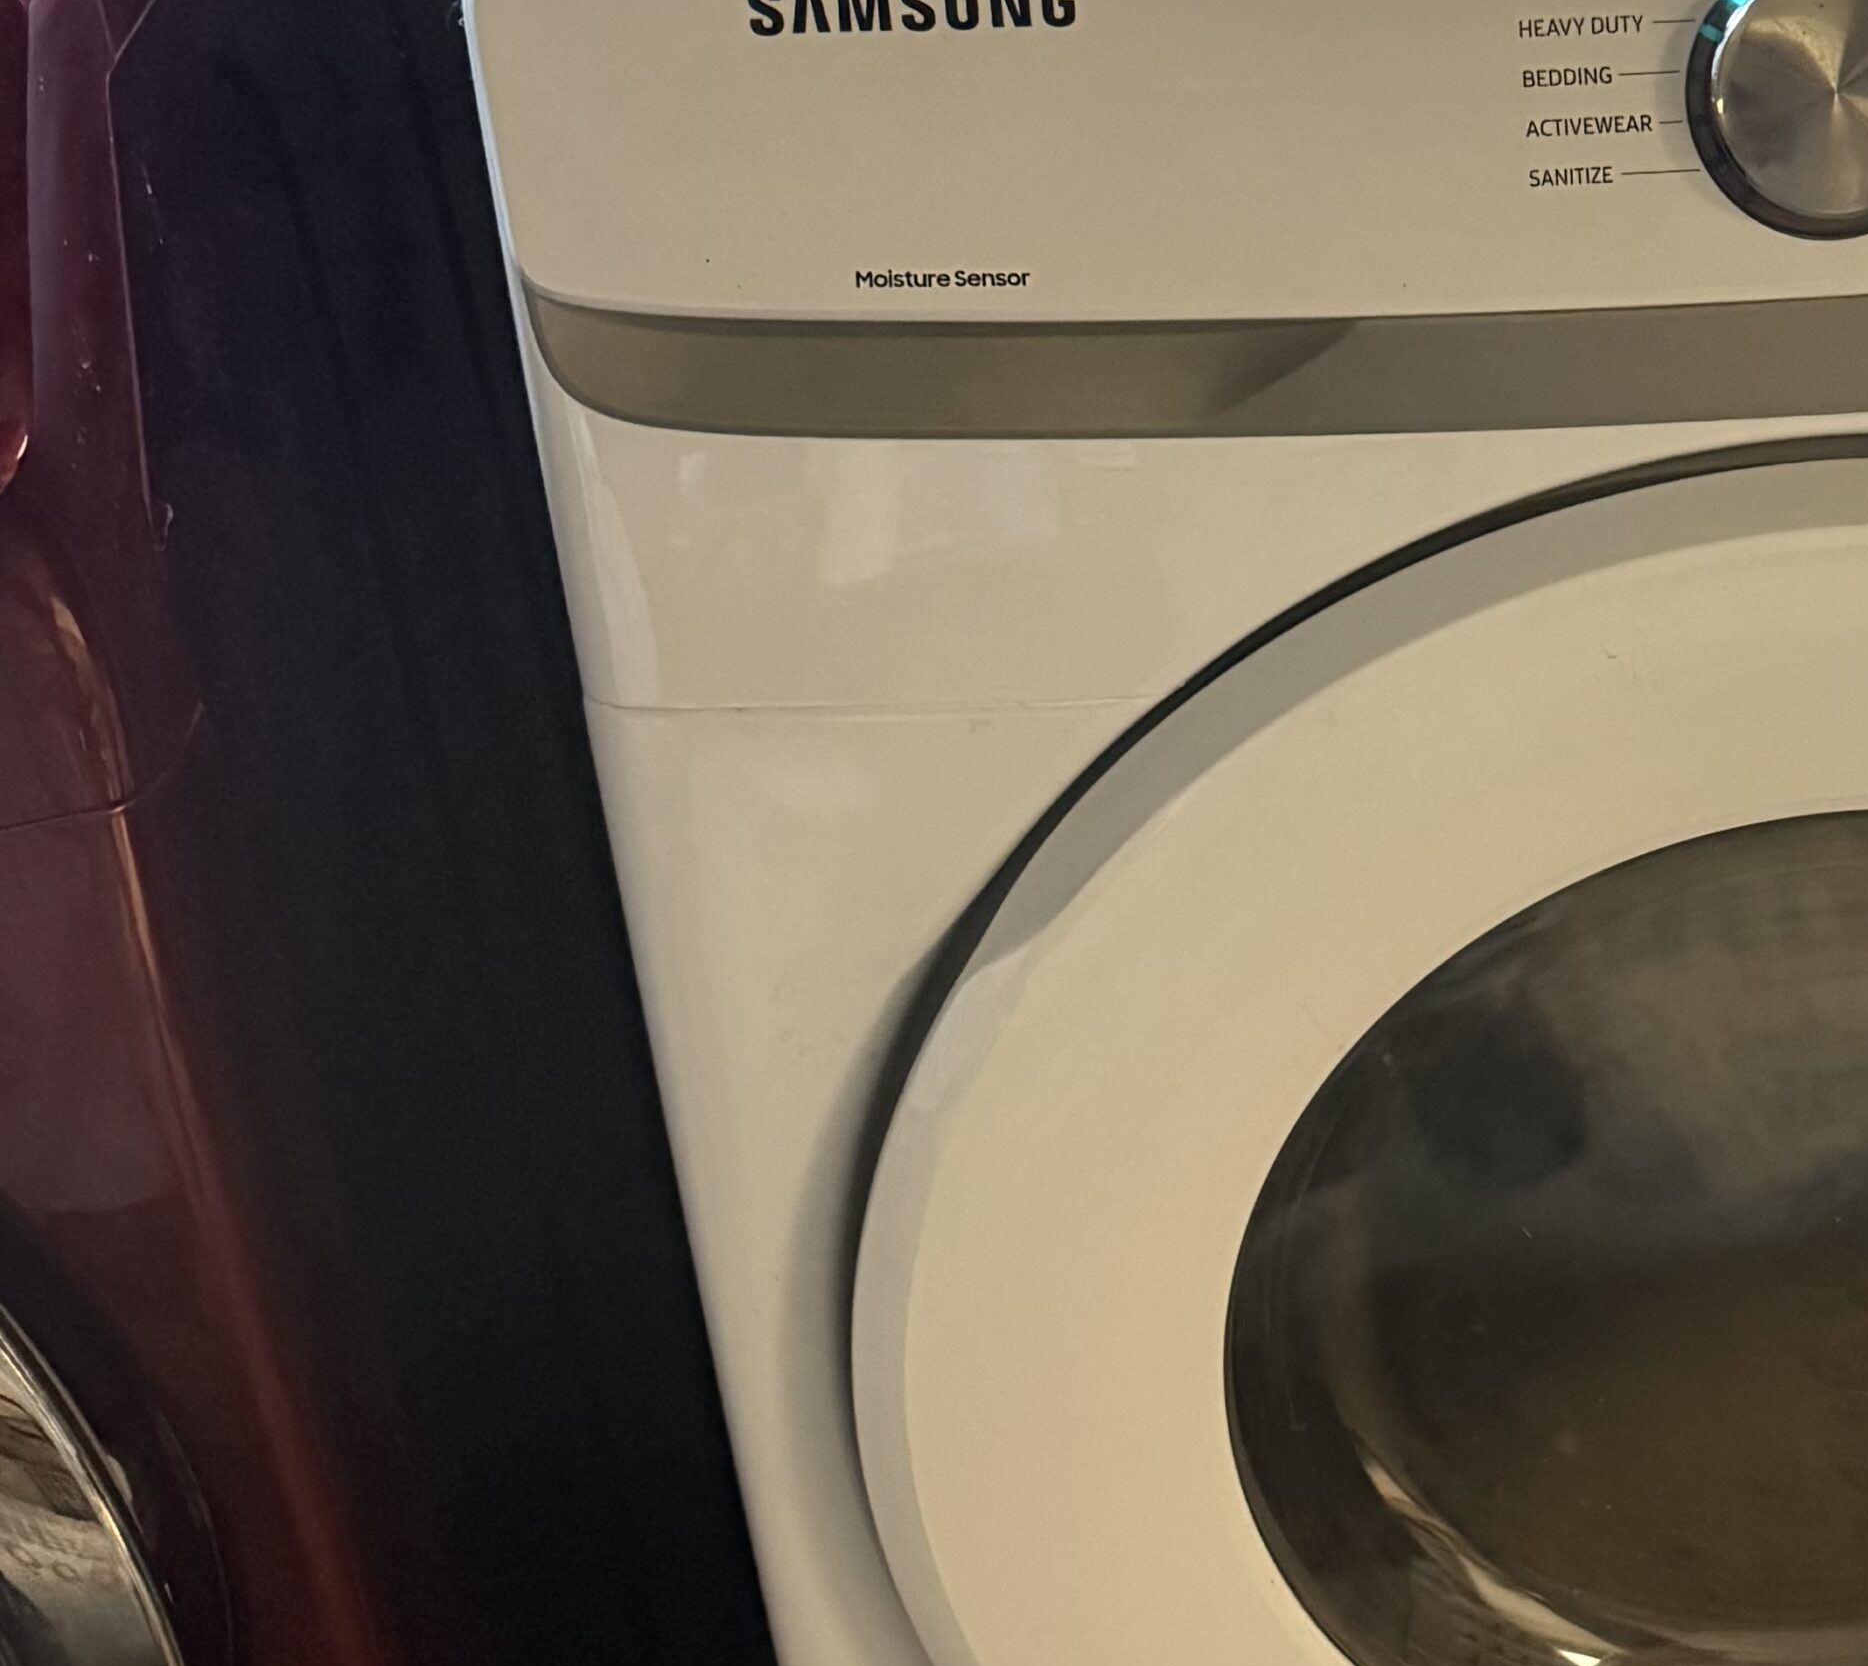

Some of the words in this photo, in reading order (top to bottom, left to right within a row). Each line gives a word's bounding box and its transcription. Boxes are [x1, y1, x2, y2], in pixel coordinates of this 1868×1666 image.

[1519, 18, 1584, 38] HEAVY
[1592, 15, 1643, 34] DUTY
[1523, 67, 1612, 87] BEDDING
[1526, 115, 1652, 137] ACTIVEWEAR
[1530, 166, 1613, 187] SANITIZE
[856, 270, 950, 288] Moisture
[955, 271, 1030, 287] Sensor
